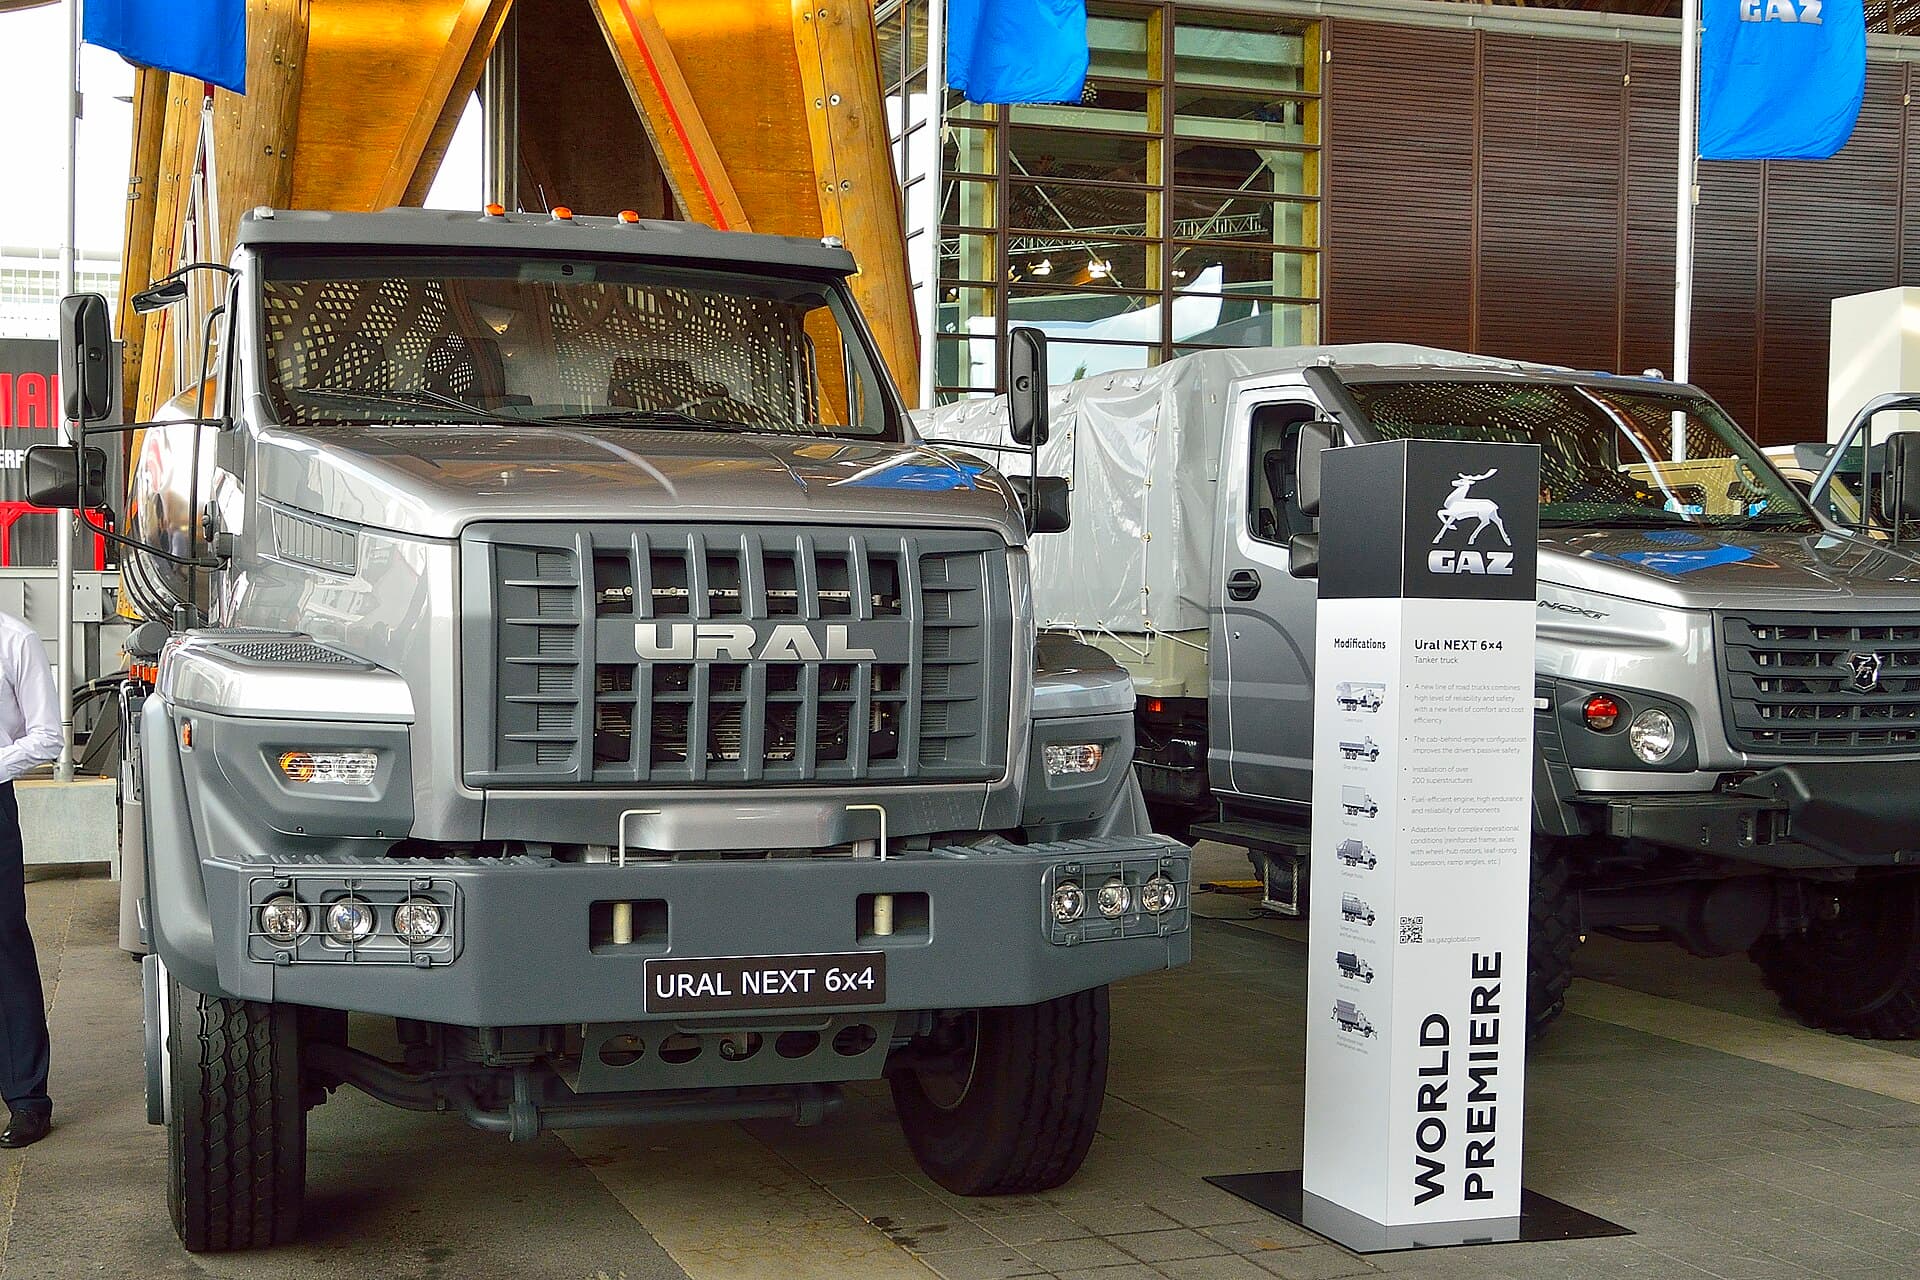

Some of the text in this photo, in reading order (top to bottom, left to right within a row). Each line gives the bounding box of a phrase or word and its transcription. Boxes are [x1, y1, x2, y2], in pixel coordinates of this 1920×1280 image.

[1740, 0, 1823, 24] GAZ
[1428, 550, 1514, 574] GAZ
[634, 624, 877, 660] URAL
[1334, 638, 1386, 649] Modifications
[1414, 640, 1440, 650] Ural
[1444, 640, 1477, 650] NEXT
[656, 967, 875, 998] URAL NEXT 6x4
[1464, 952, 1502, 1200] PREMIERE
[1414, 1013, 1450, 1206] WORLD
